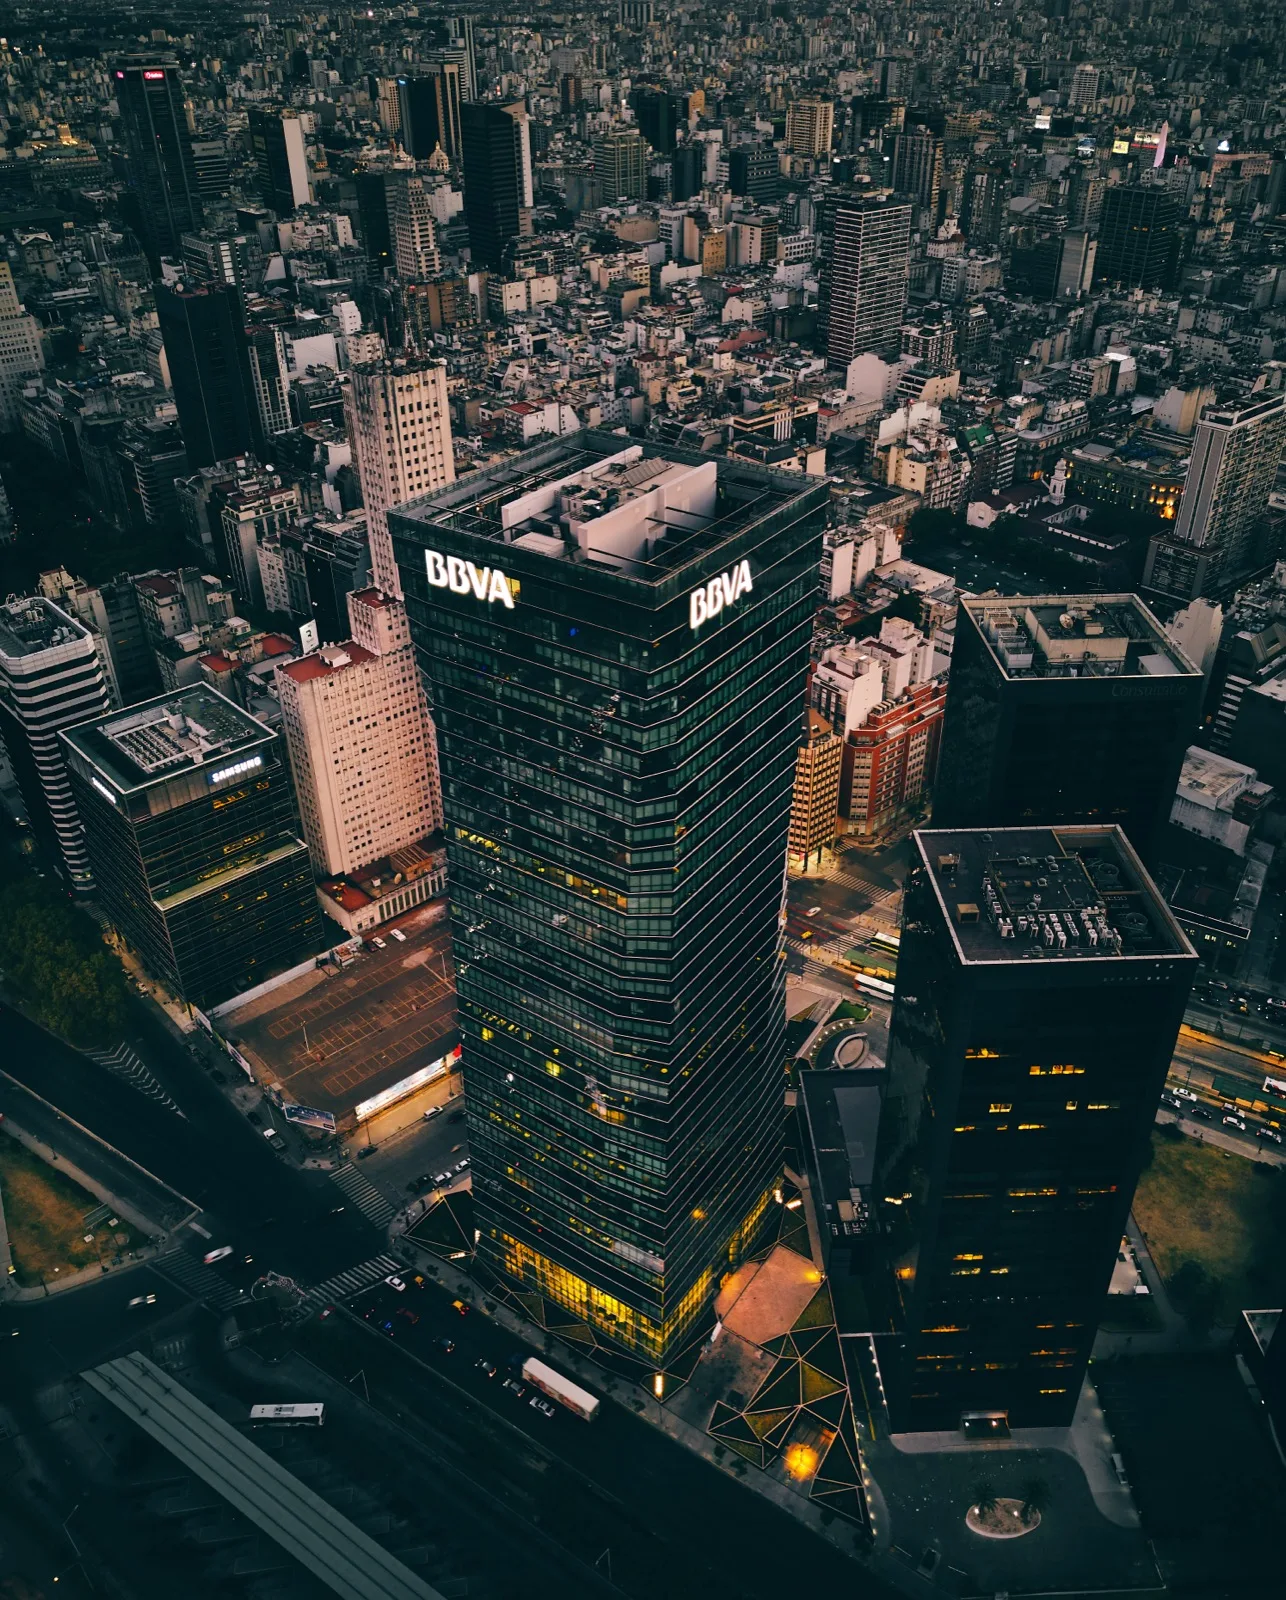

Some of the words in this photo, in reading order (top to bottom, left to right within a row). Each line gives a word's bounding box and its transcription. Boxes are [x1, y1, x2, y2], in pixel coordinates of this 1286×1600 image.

[424, 548, 515, 609] BBVA
[689, 559, 754, 630] BBVA
[211, 756, 262, 783] SAMSUNG
